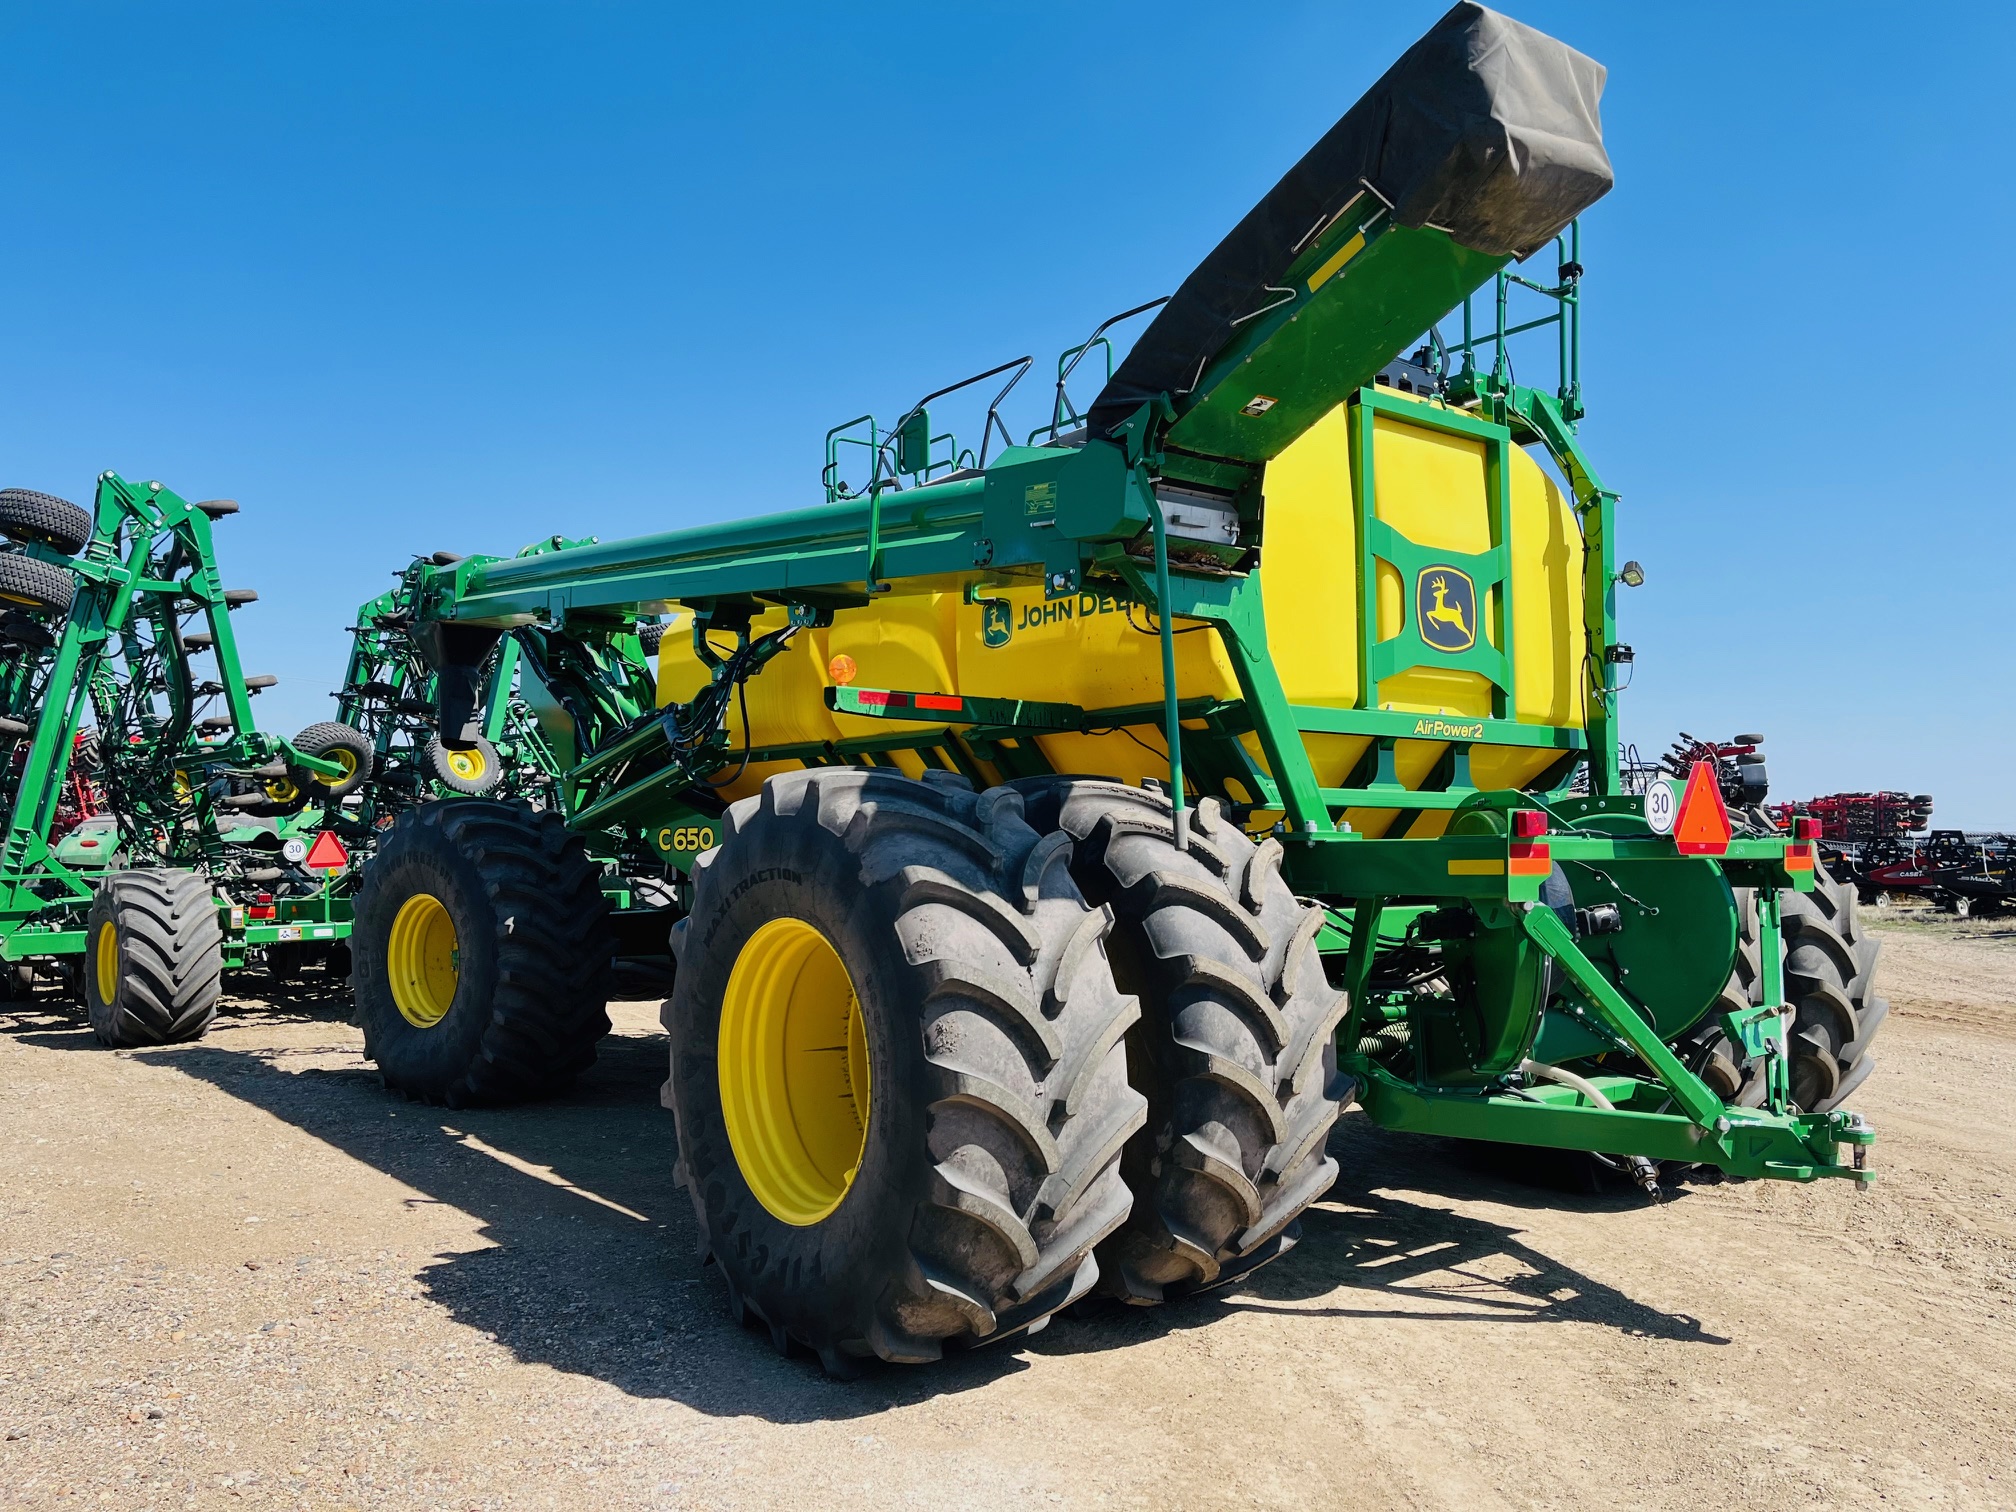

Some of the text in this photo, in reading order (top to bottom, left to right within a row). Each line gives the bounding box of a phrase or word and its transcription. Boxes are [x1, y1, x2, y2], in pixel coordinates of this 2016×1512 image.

[1018, 592, 1138, 630] JOHN DEE
[1413, 719, 1483, 738] AirPower2
[1652, 793, 1669, 814] 30
[1654, 815, 1668, 824] km/h
[288, 844, 302, 854] 30
[658, 826, 714, 852] C650
[702, 867, 803, 949] MAXI TRACTION
